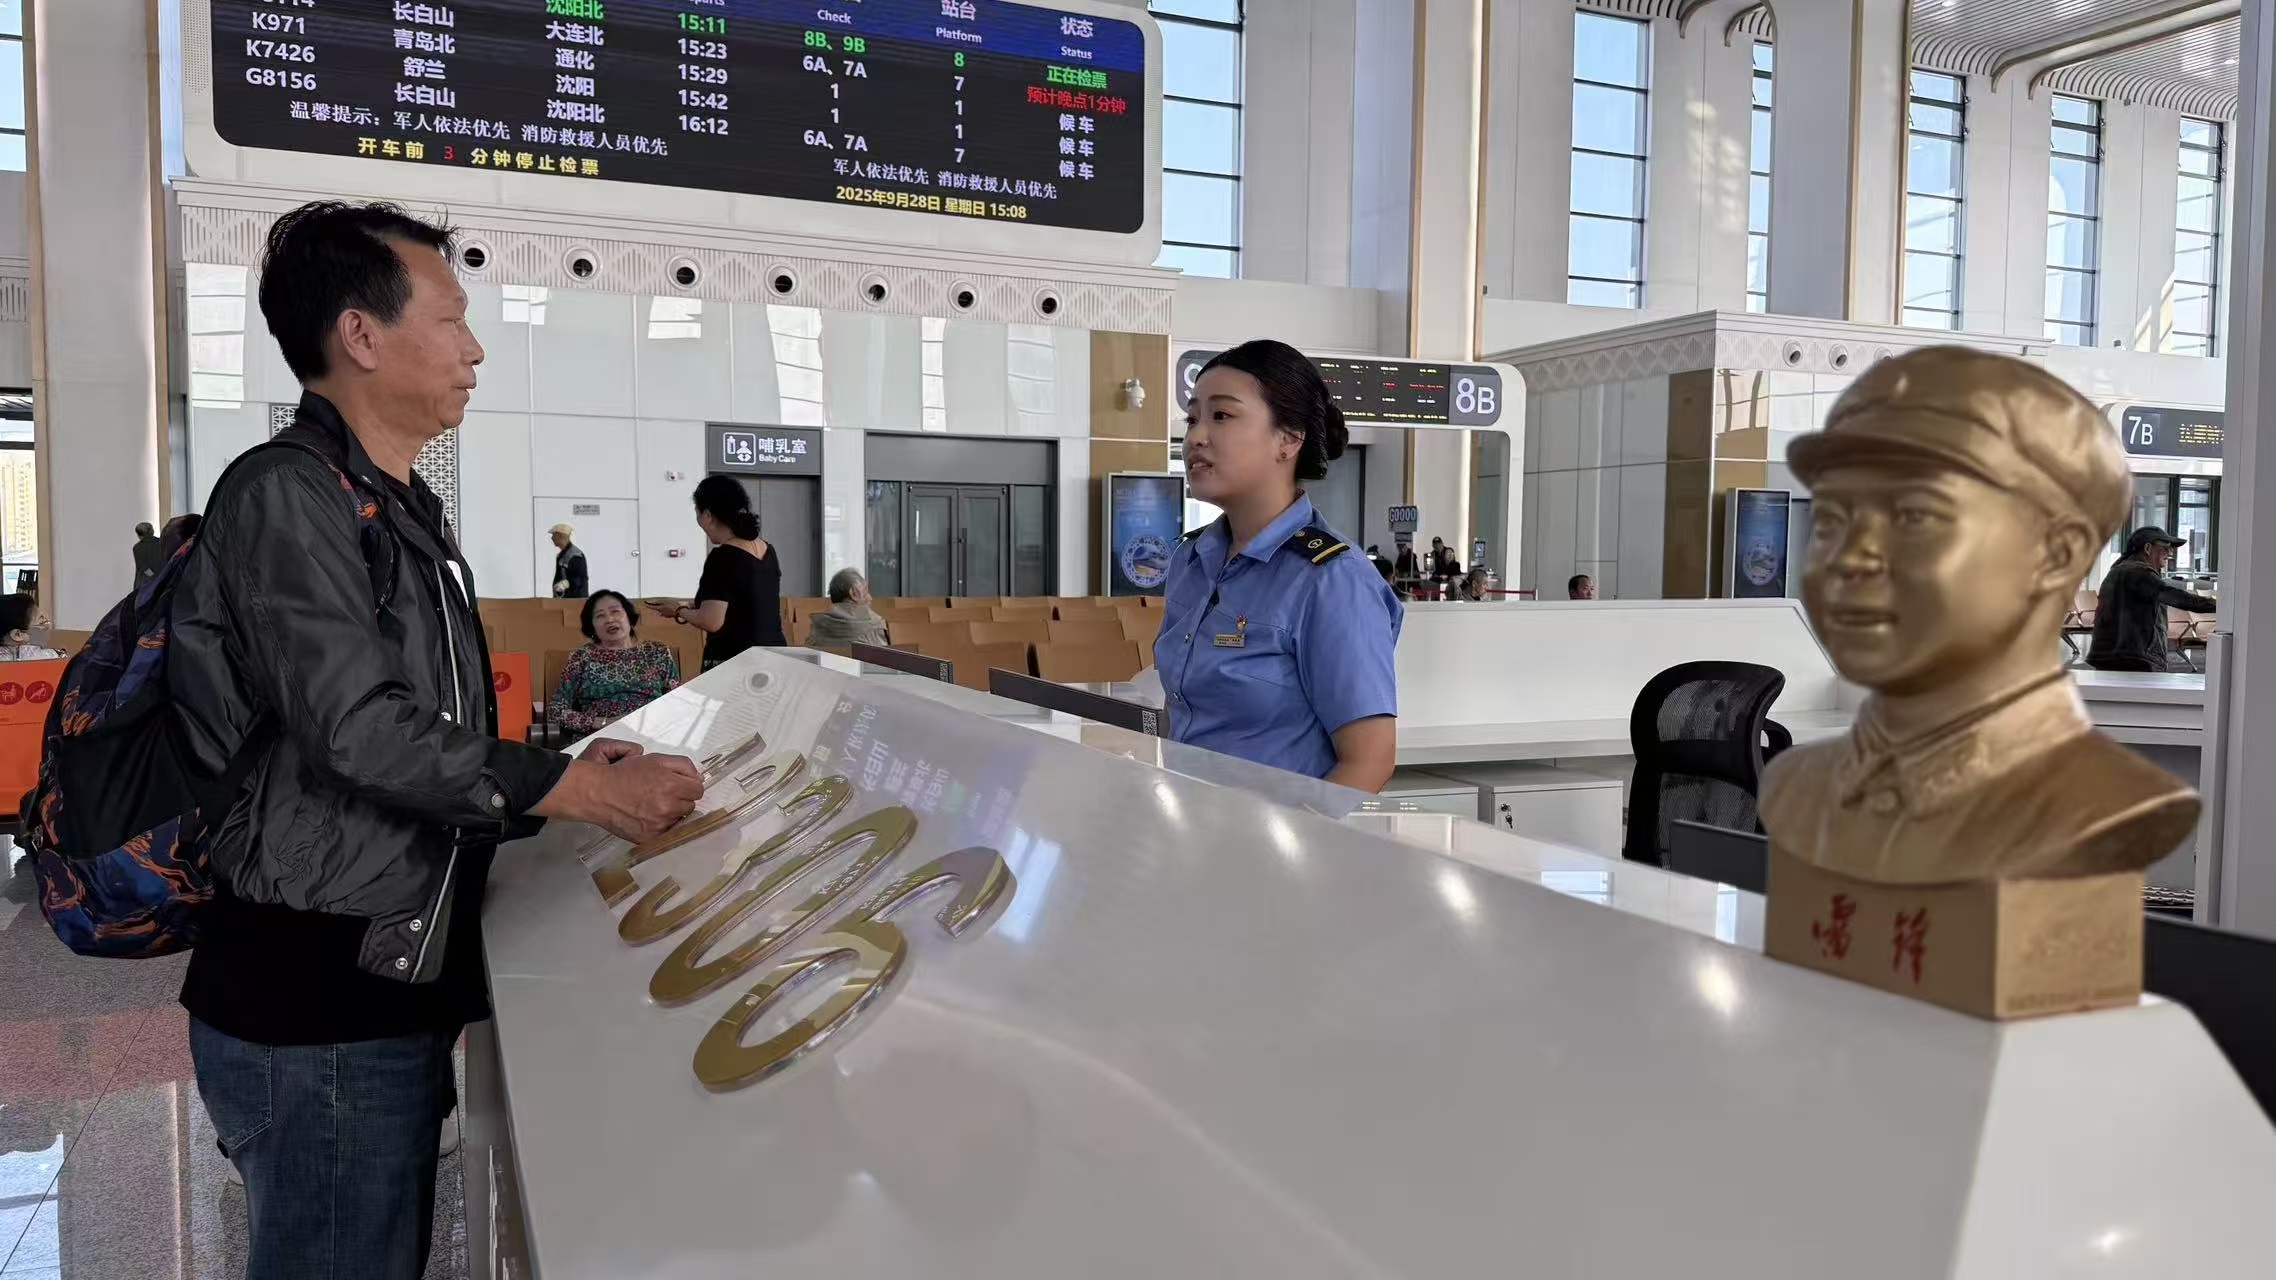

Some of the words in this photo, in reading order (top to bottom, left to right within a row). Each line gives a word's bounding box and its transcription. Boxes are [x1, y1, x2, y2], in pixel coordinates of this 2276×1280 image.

[817, 10, 851, 24] Check
[936, 27, 982, 43] Platform
[1061, 46, 1092, 59] Status
[941, 0, 976, 20] 站台
[1061, 14, 1096, 37] 状态
[253, 12, 304, 34] K971
[394, 29, 455, 53] 青岛北
[556, 48, 594, 70] 通化
[679, 64, 727, 84] 15:29
[830, 84, 839, 98] 1
[954, 100, 963, 115] 1
[393, 1, 453, 27] 长白山
[546, 21, 603, 45] 大连北
[678, 38, 727, 59] 15:23
[954, 76, 965, 90] 7
[1026, 86, 1127, 114] 预计晚点1分钟
[546, 0, 603, 19] 沈阳北
[679, 13, 724, 33] 15:11
[954, 53, 965, 66] 8
[1046, 65, 1108, 89] 正在检票
[247, 39, 315, 62] K7426
[404, 57, 445, 79] 舒兰
[556, 74, 594, 96] 沈阳
[679, 90, 728, 109] 15:42
[830, 108, 839, 123] 1
[954, 124, 963, 138] 1
[246, 68, 316, 90] G8156
[394, 83, 455, 108] 长白山
[547, 99, 604, 123] 沈阳北
[679, 115, 728, 135] 16:12
[954, 148, 965, 162] 7
[357, 137, 425, 160] 开车前
[443, 146, 454, 159] 3
[470, 148, 600, 175] 分钟停止检票
[520, 124, 669, 157] 消防救援人员优先
[833, 158, 929, 186] 军人依法优先
[937, 171, 1058, 199] 消防救援人员优先
[836, 186, 941, 211] 2025年9月28日
[944, 197, 986, 216] 星期日
[990, 203, 1026, 218] 15:08
[1456, 377, 1494, 413] 8B
[758, 438, 806, 454] 哺乳室
[2128, 416, 2153, 445] 7B
[759, 454, 777, 463] Baby
[778, 455, 796, 463] Care
